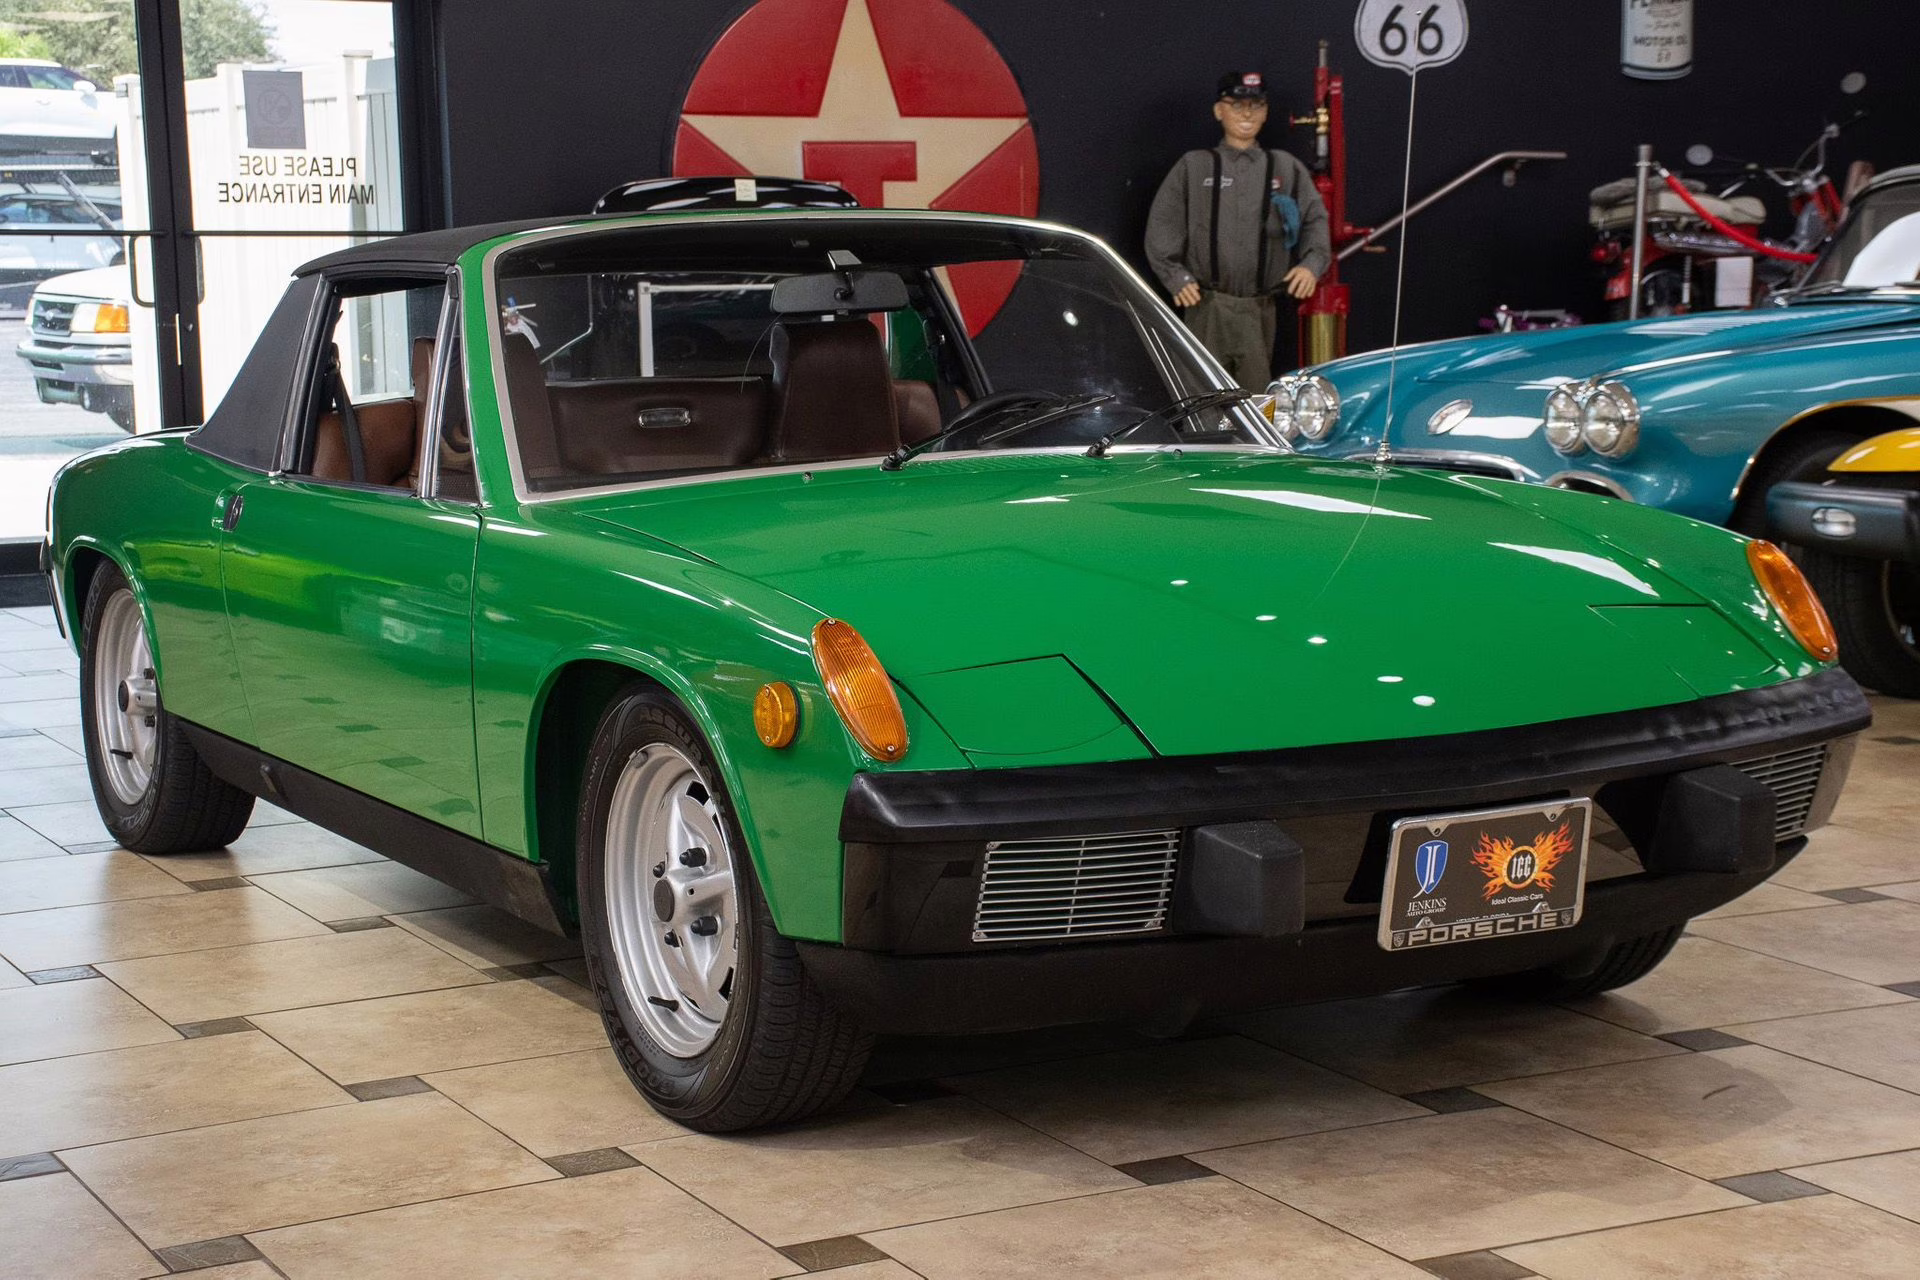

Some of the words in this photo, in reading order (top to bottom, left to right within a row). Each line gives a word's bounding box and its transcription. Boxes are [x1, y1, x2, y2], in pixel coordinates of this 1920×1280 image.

[1379, 4, 1443, 56] 66
[1491, 897, 1507, 906] Ideal
[1507, 894, 1529, 904] Classic
[1529, 893, 1544, 901] Cars
[1408, 912, 1558, 946] PORSCHE
